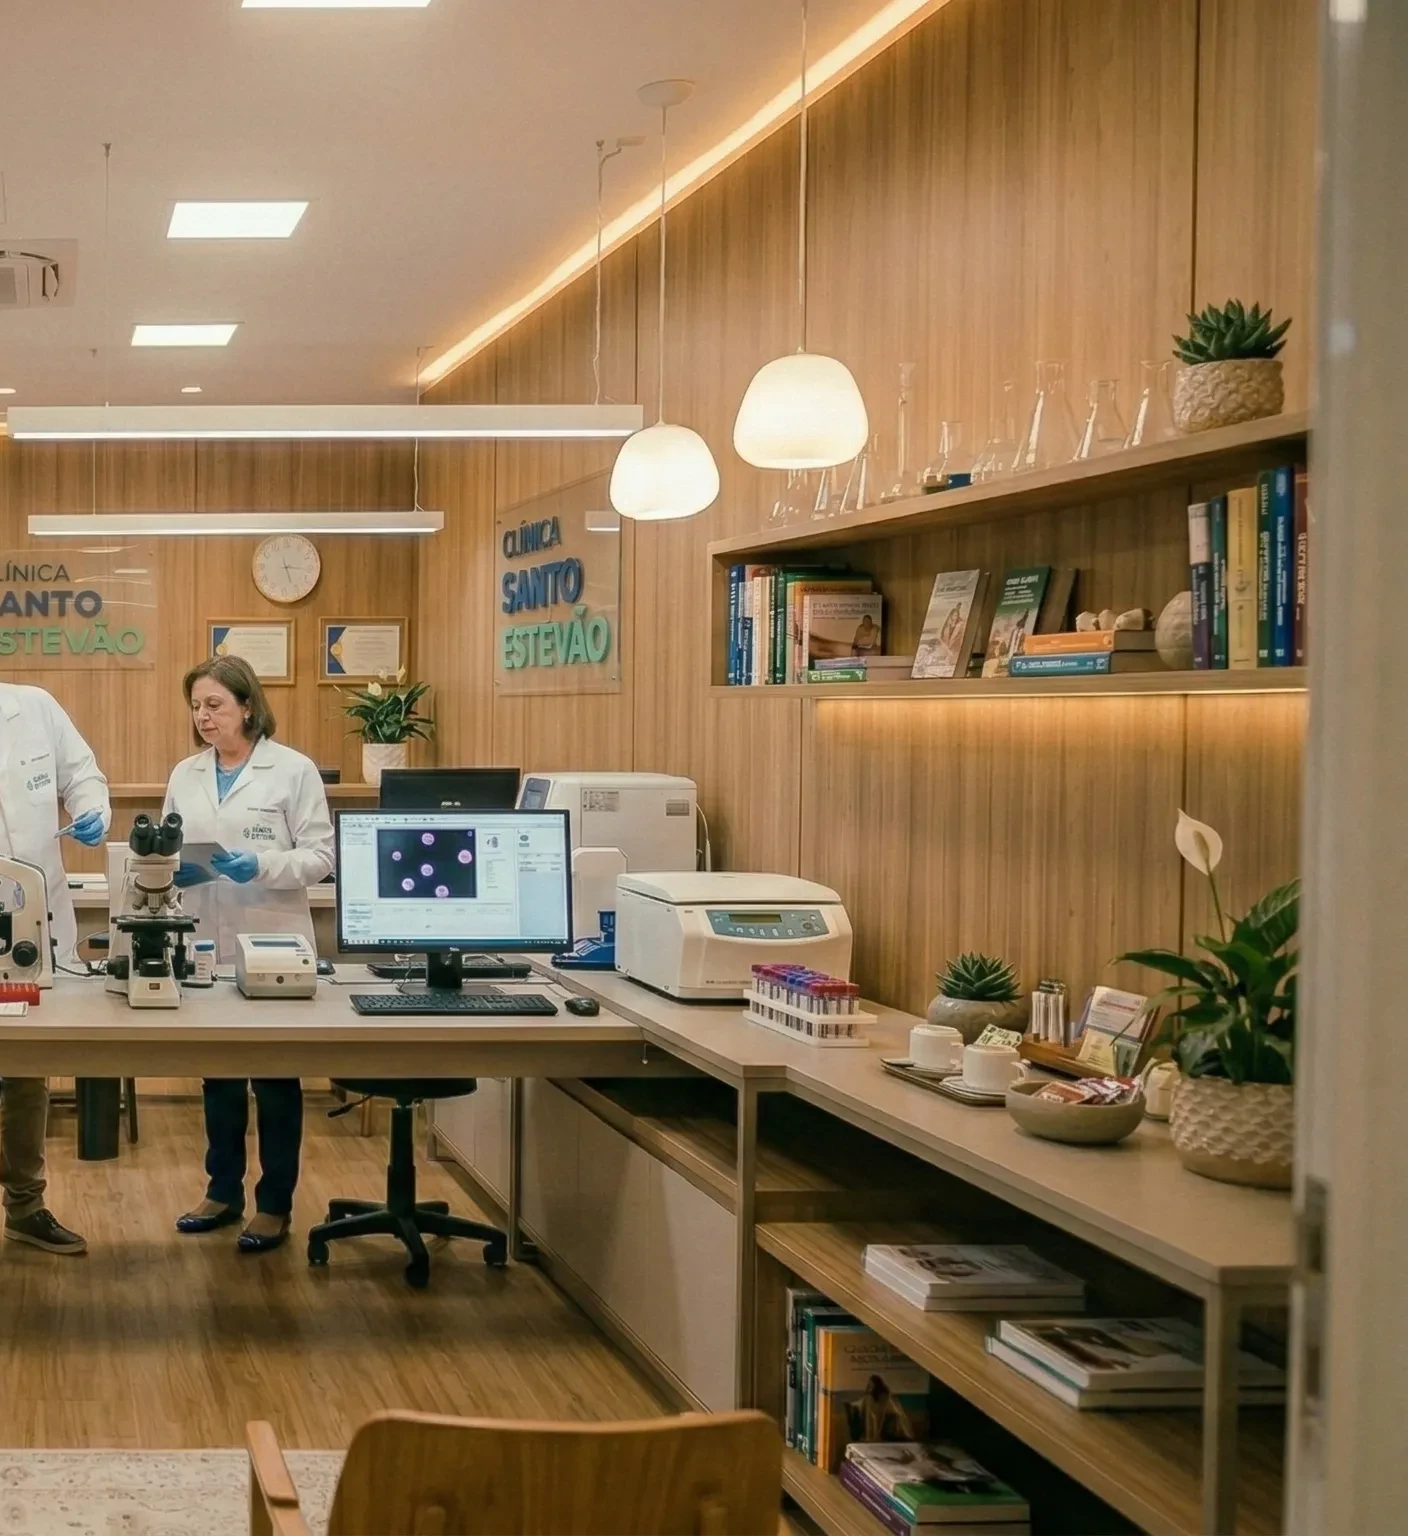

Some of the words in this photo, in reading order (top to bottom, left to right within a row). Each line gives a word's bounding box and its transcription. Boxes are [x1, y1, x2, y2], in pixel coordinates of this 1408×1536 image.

[503, 516, 562, 558] CLÍNICA
[502, 557, 585, 614] SANTO
[501, 604, 610, 669] ESTEVÃO
